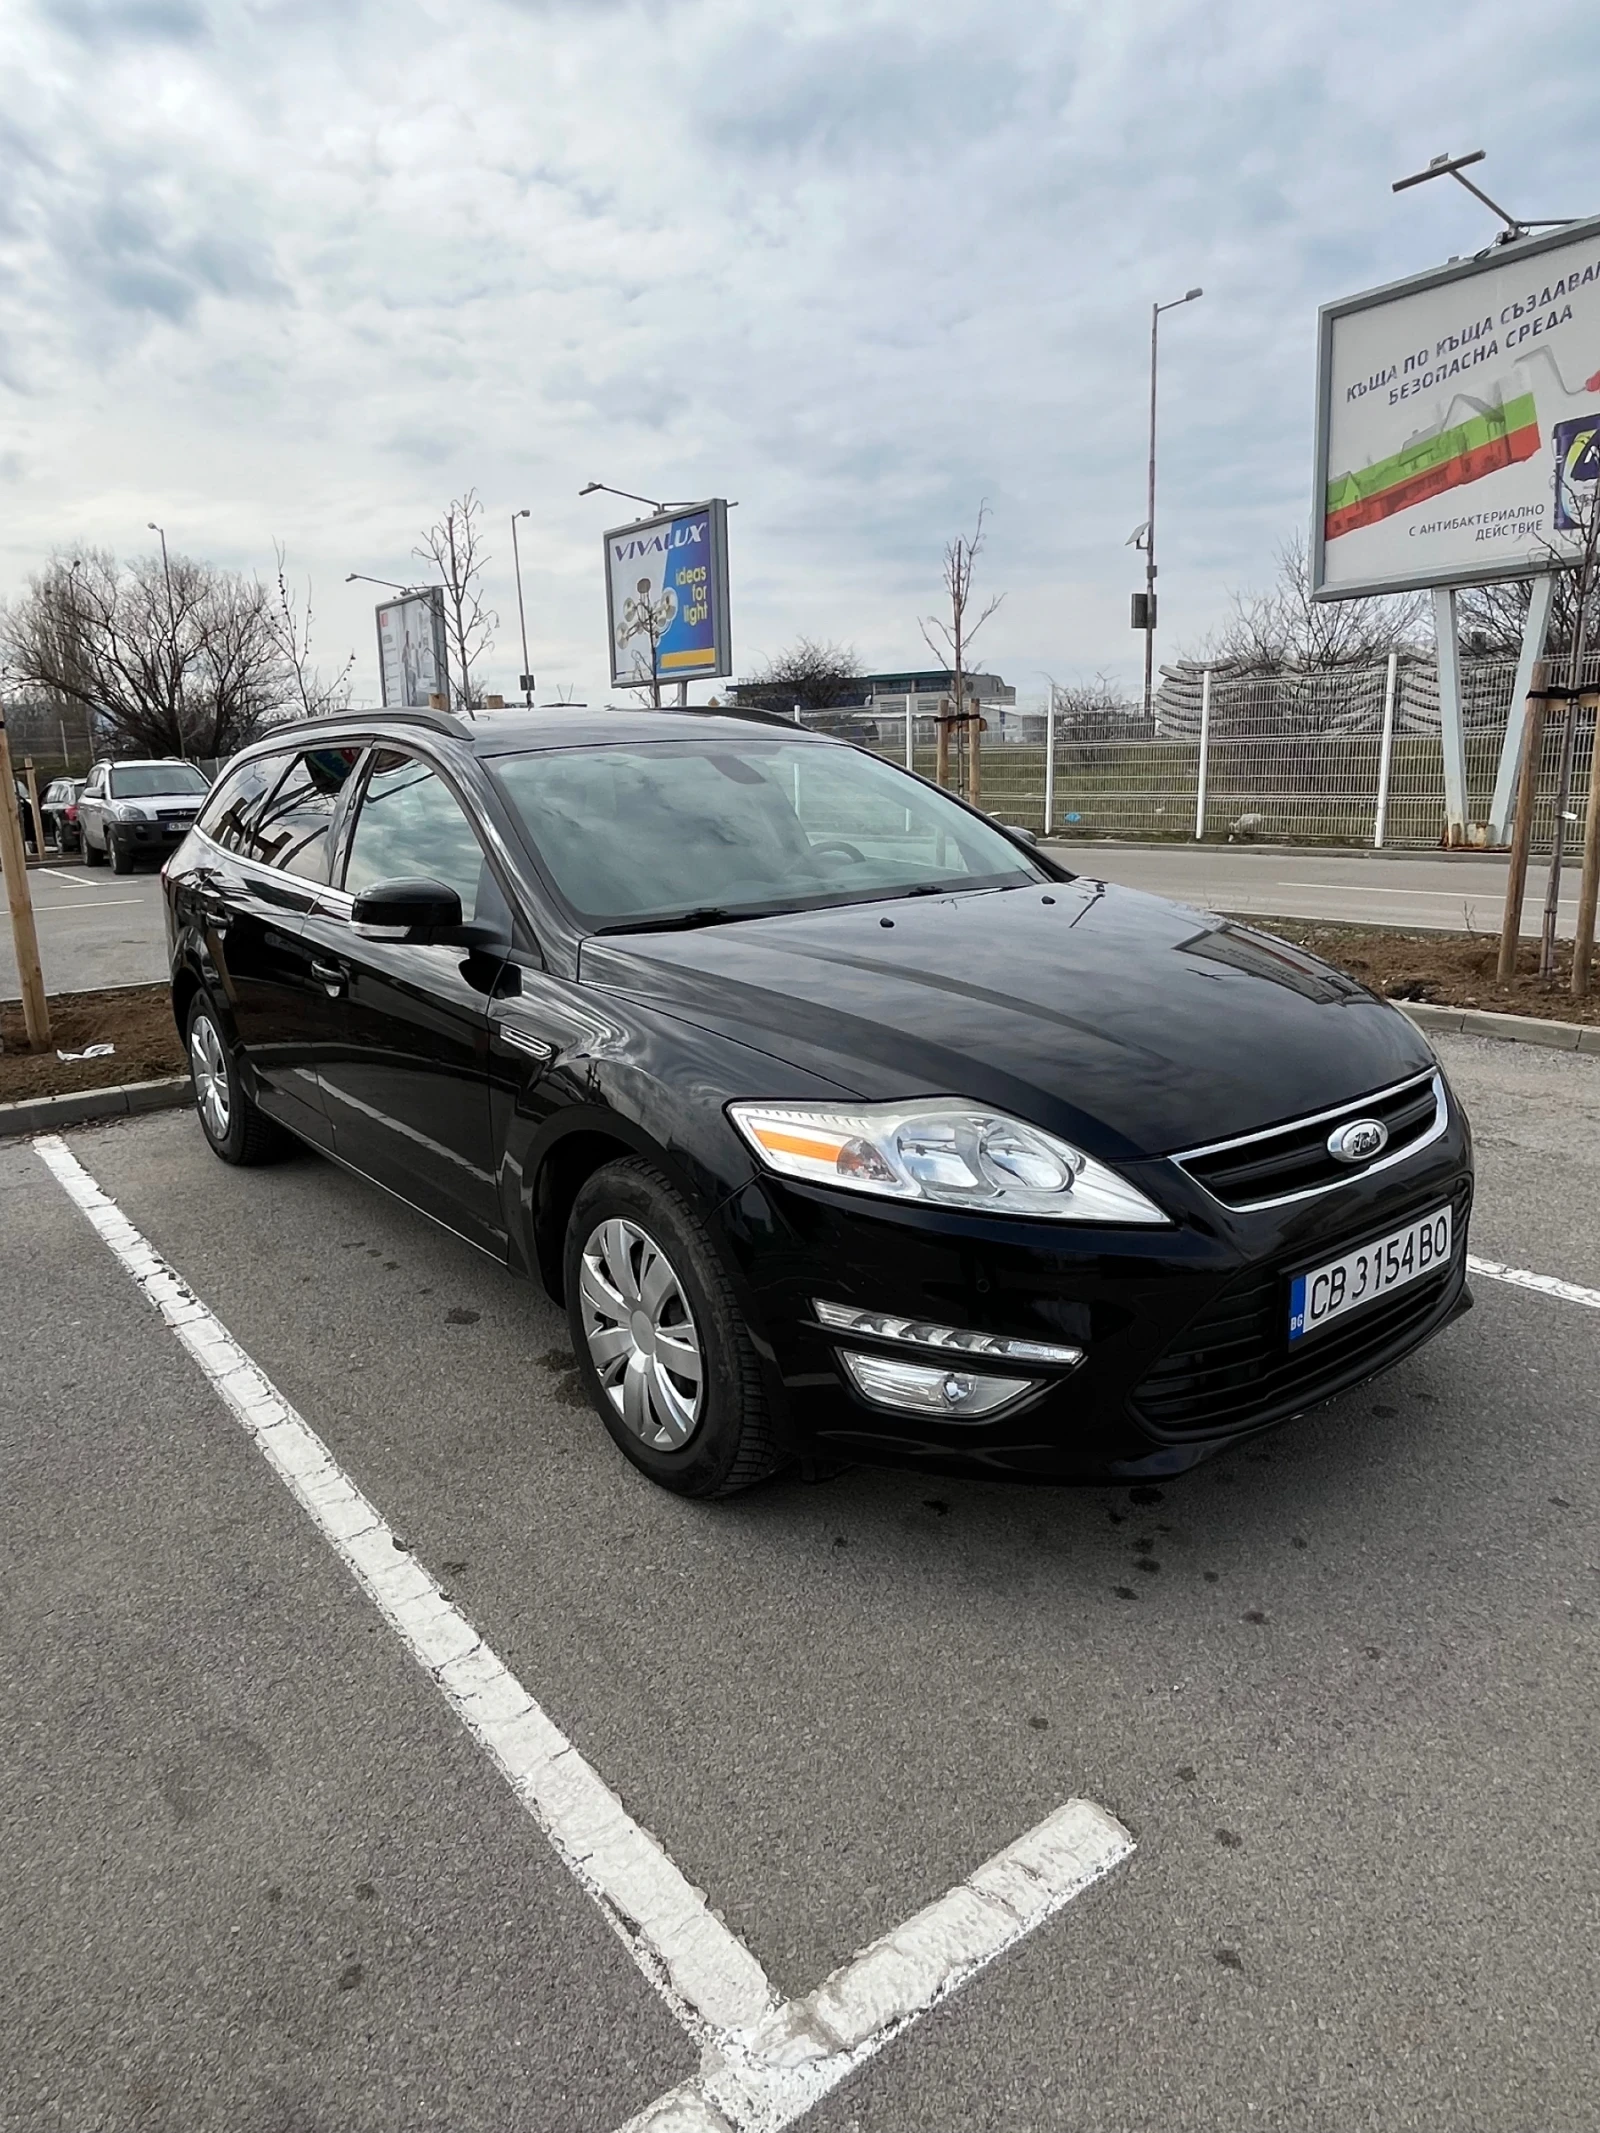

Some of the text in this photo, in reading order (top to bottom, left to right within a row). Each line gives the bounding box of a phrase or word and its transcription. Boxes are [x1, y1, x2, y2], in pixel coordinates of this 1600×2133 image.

[1346, 365, 1398, 403] КЪЩА
[1403, 349, 1429, 374] ПО
[1436, 316, 1493, 358] КЪЩА
[1388, 304, 1573, 406] БЕЗОПАСНА СРЕДА
[1408, 503, 1545, 537] С АНТИБАКТЕРИАЛНО
[1475, 519, 1543, 542] ДЕЙСТВИЕ
[615, 522, 707, 562] VIVALUX
[676, 565, 707, 586] ideas
[692, 585, 707, 602] for
[684, 603, 708, 626] light
[1352, 1127, 1378, 1152] Ford
[1290, 1313, 1303, 1332] BG
